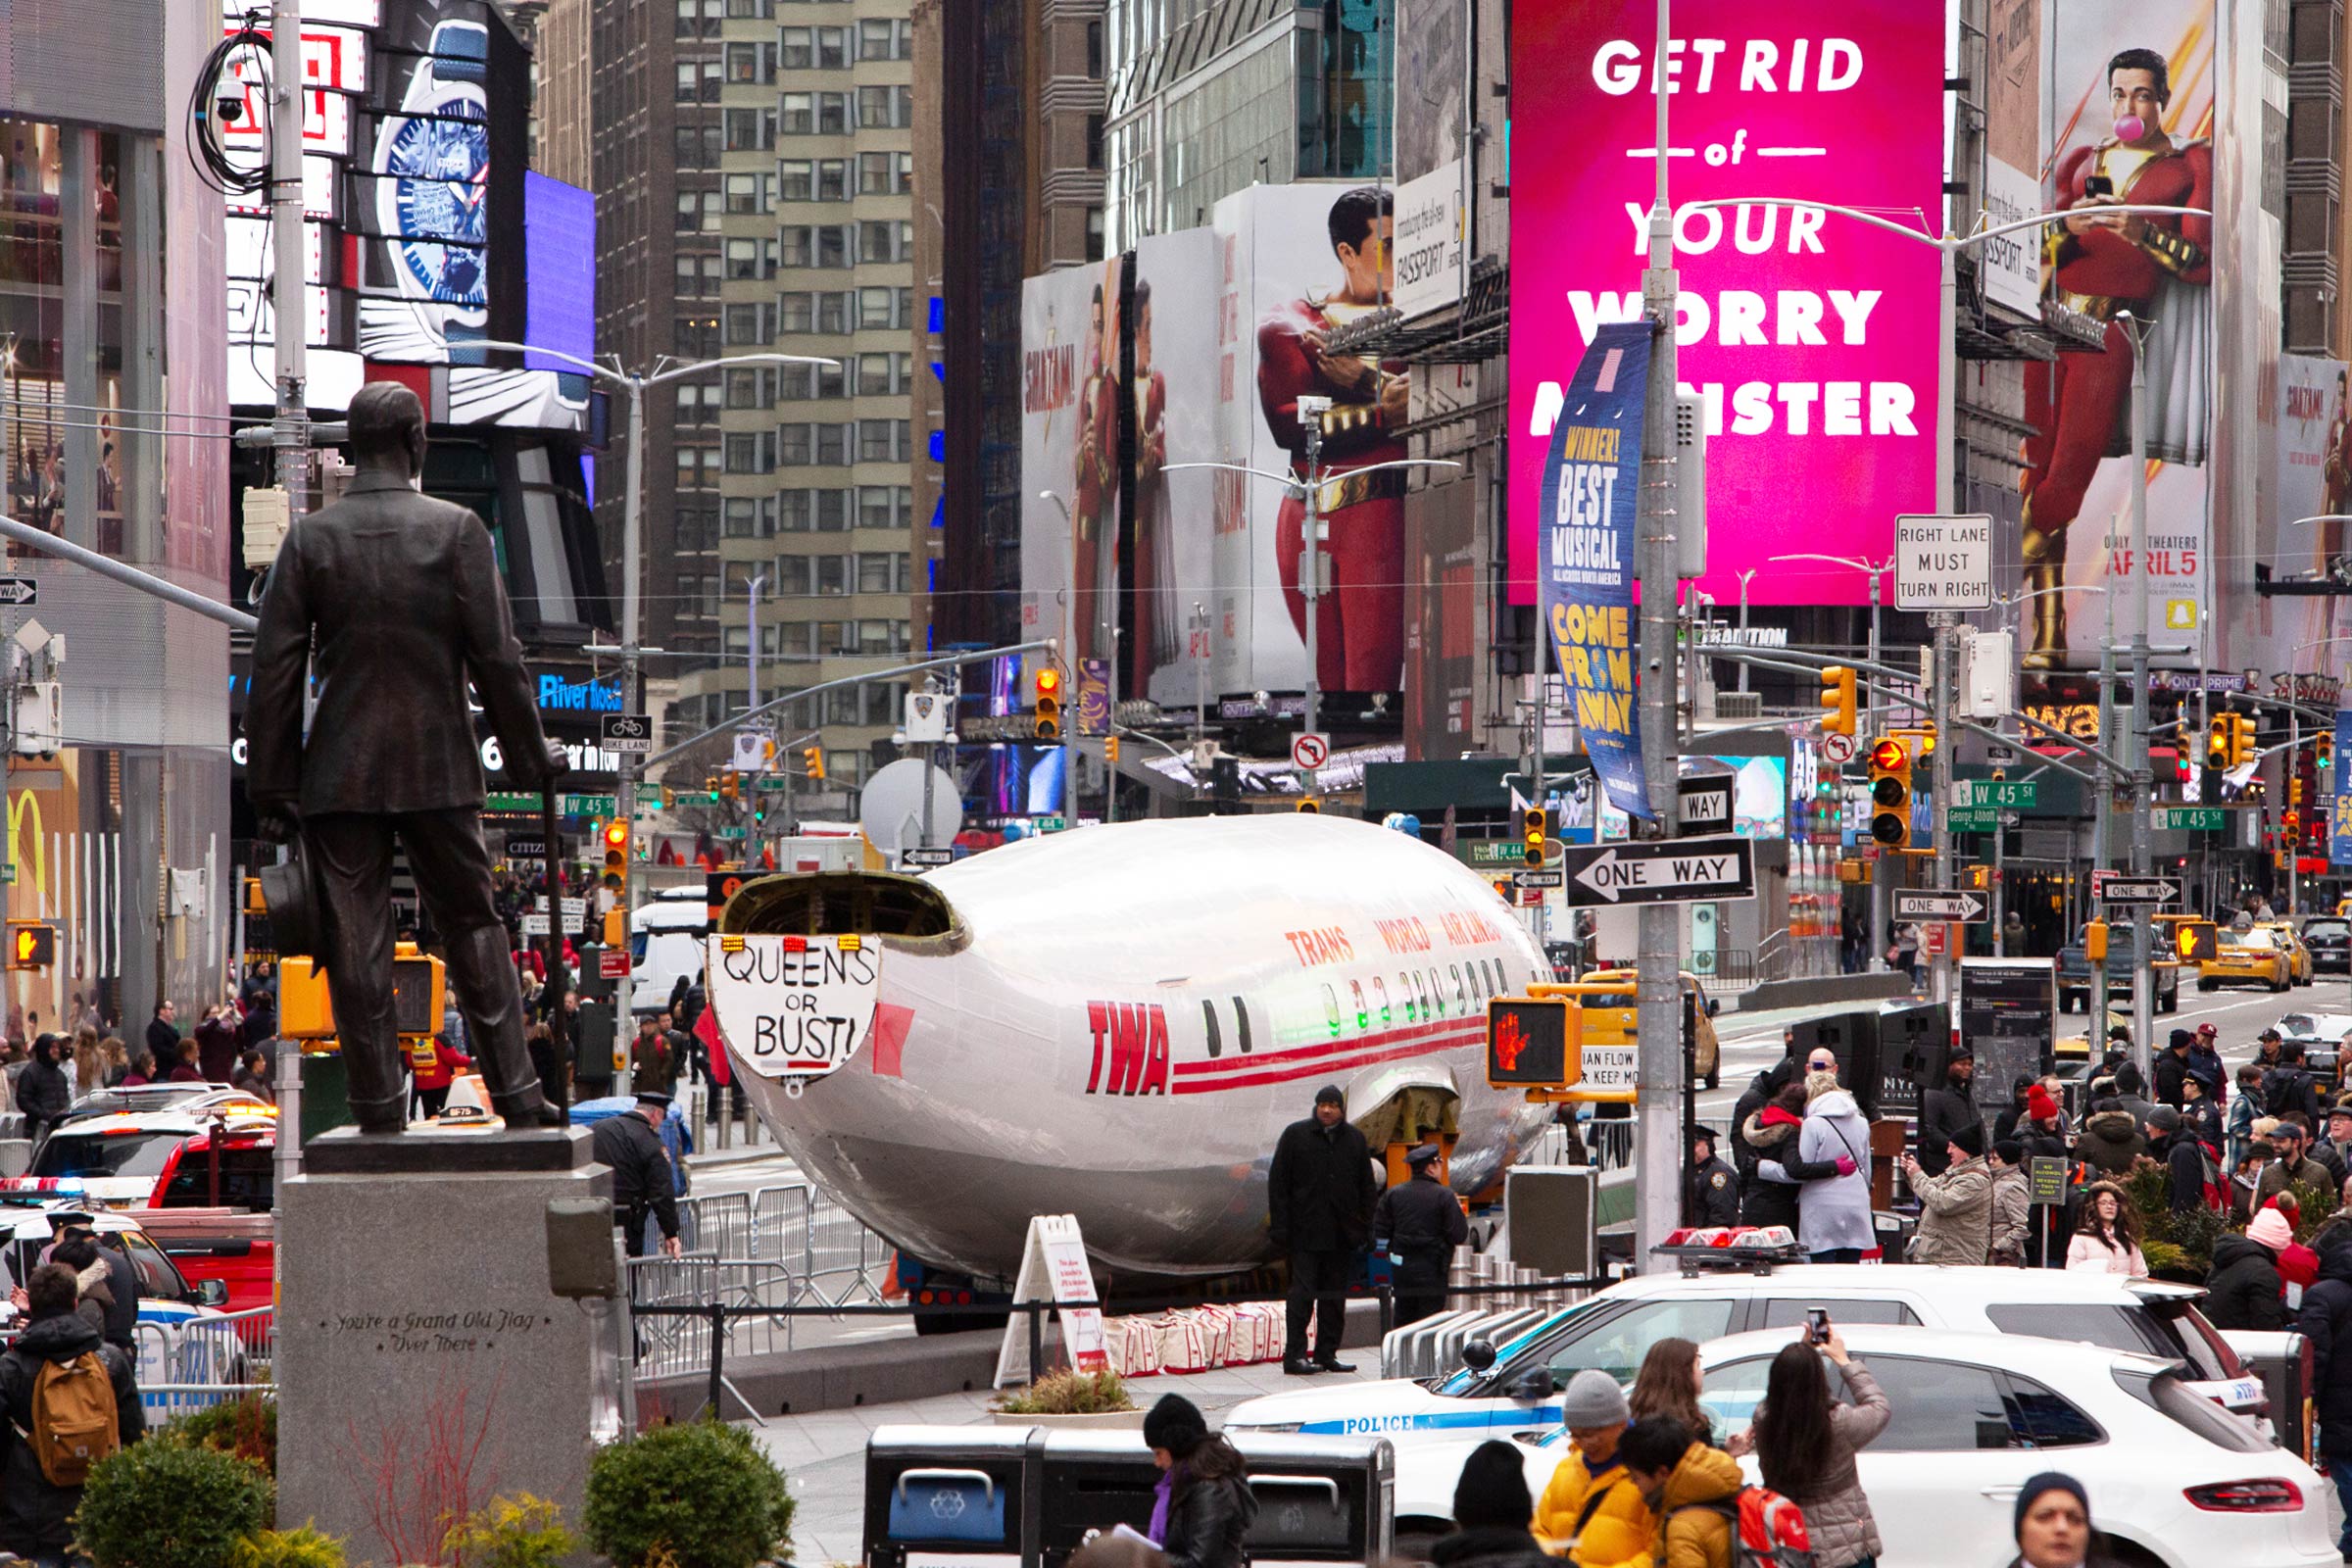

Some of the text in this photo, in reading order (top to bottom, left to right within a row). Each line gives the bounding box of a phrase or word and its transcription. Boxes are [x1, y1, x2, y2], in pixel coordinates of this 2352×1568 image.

[1592, 38, 1863, 95] GET RID
[1704, 128, 1747, 167] of
[1625, 201, 1826, 255] YOUR
[1397, 241, 1446, 290] PASSPORT
[1568, 290, 1883, 346] WORRY
[1564, 425, 1621, 464] WINNER!
[1556, 464, 1619, 527] BEST
[1900, 528, 1987, 542] RIGHT LANE
[2147, 535, 2197, 549] THEATERS
[1551, 527, 1622, 570] MUSICAL
[1918, 554, 1969, 571] MUST
[2180, 551, 2196, 576] 5
[1899, 582, 1987, 597] TURN RIGHT
[1552, 603, 1629, 648] COME
[1557, 645, 1632, 692] FROM
[539, 674, 587, 710] River
[2208, 677, 2242, 689] PRIME
[1576, 689, 1633, 735] AWAY
[605, 740, 649, 750] BIKE LANE
[567, 798, 614, 812] W 45 St
[1688, 794, 1721, 818] WAY
[1975, 785, 2033, 804] W 45 St
[1949, 809, 1973, 826] George
[2170, 811, 2222, 827] W 45 St
[931, 853, 946, 861] WAY
[1499, 845, 1507, 855] W
[1511, 845, 1522, 855] 44
[1594, 858, 1727, 886] ONE WAY
[2112, 886, 2171, 896] ONE WAY
[1908, 900, 1974, 912] ONE WAY
[1285, 926, 1355, 967] TRANS
[1374, 915, 1431, 956] WORLD
[723, 946, 875, 987] QUEENS
[786, 995, 817, 1013] OR
[755, 1015, 856, 1063] BUST!
[1086, 999, 1171, 1096] TWA
[1604, 1053, 1634, 1065] FLOW
[1594, 1070, 1620, 1084] KEEP
[335, 1308, 534, 1335] You're a Grand Old Flag
[391, 1333, 476, 1352] Over There
[1347, 1415, 1411, 1435] POLICE
